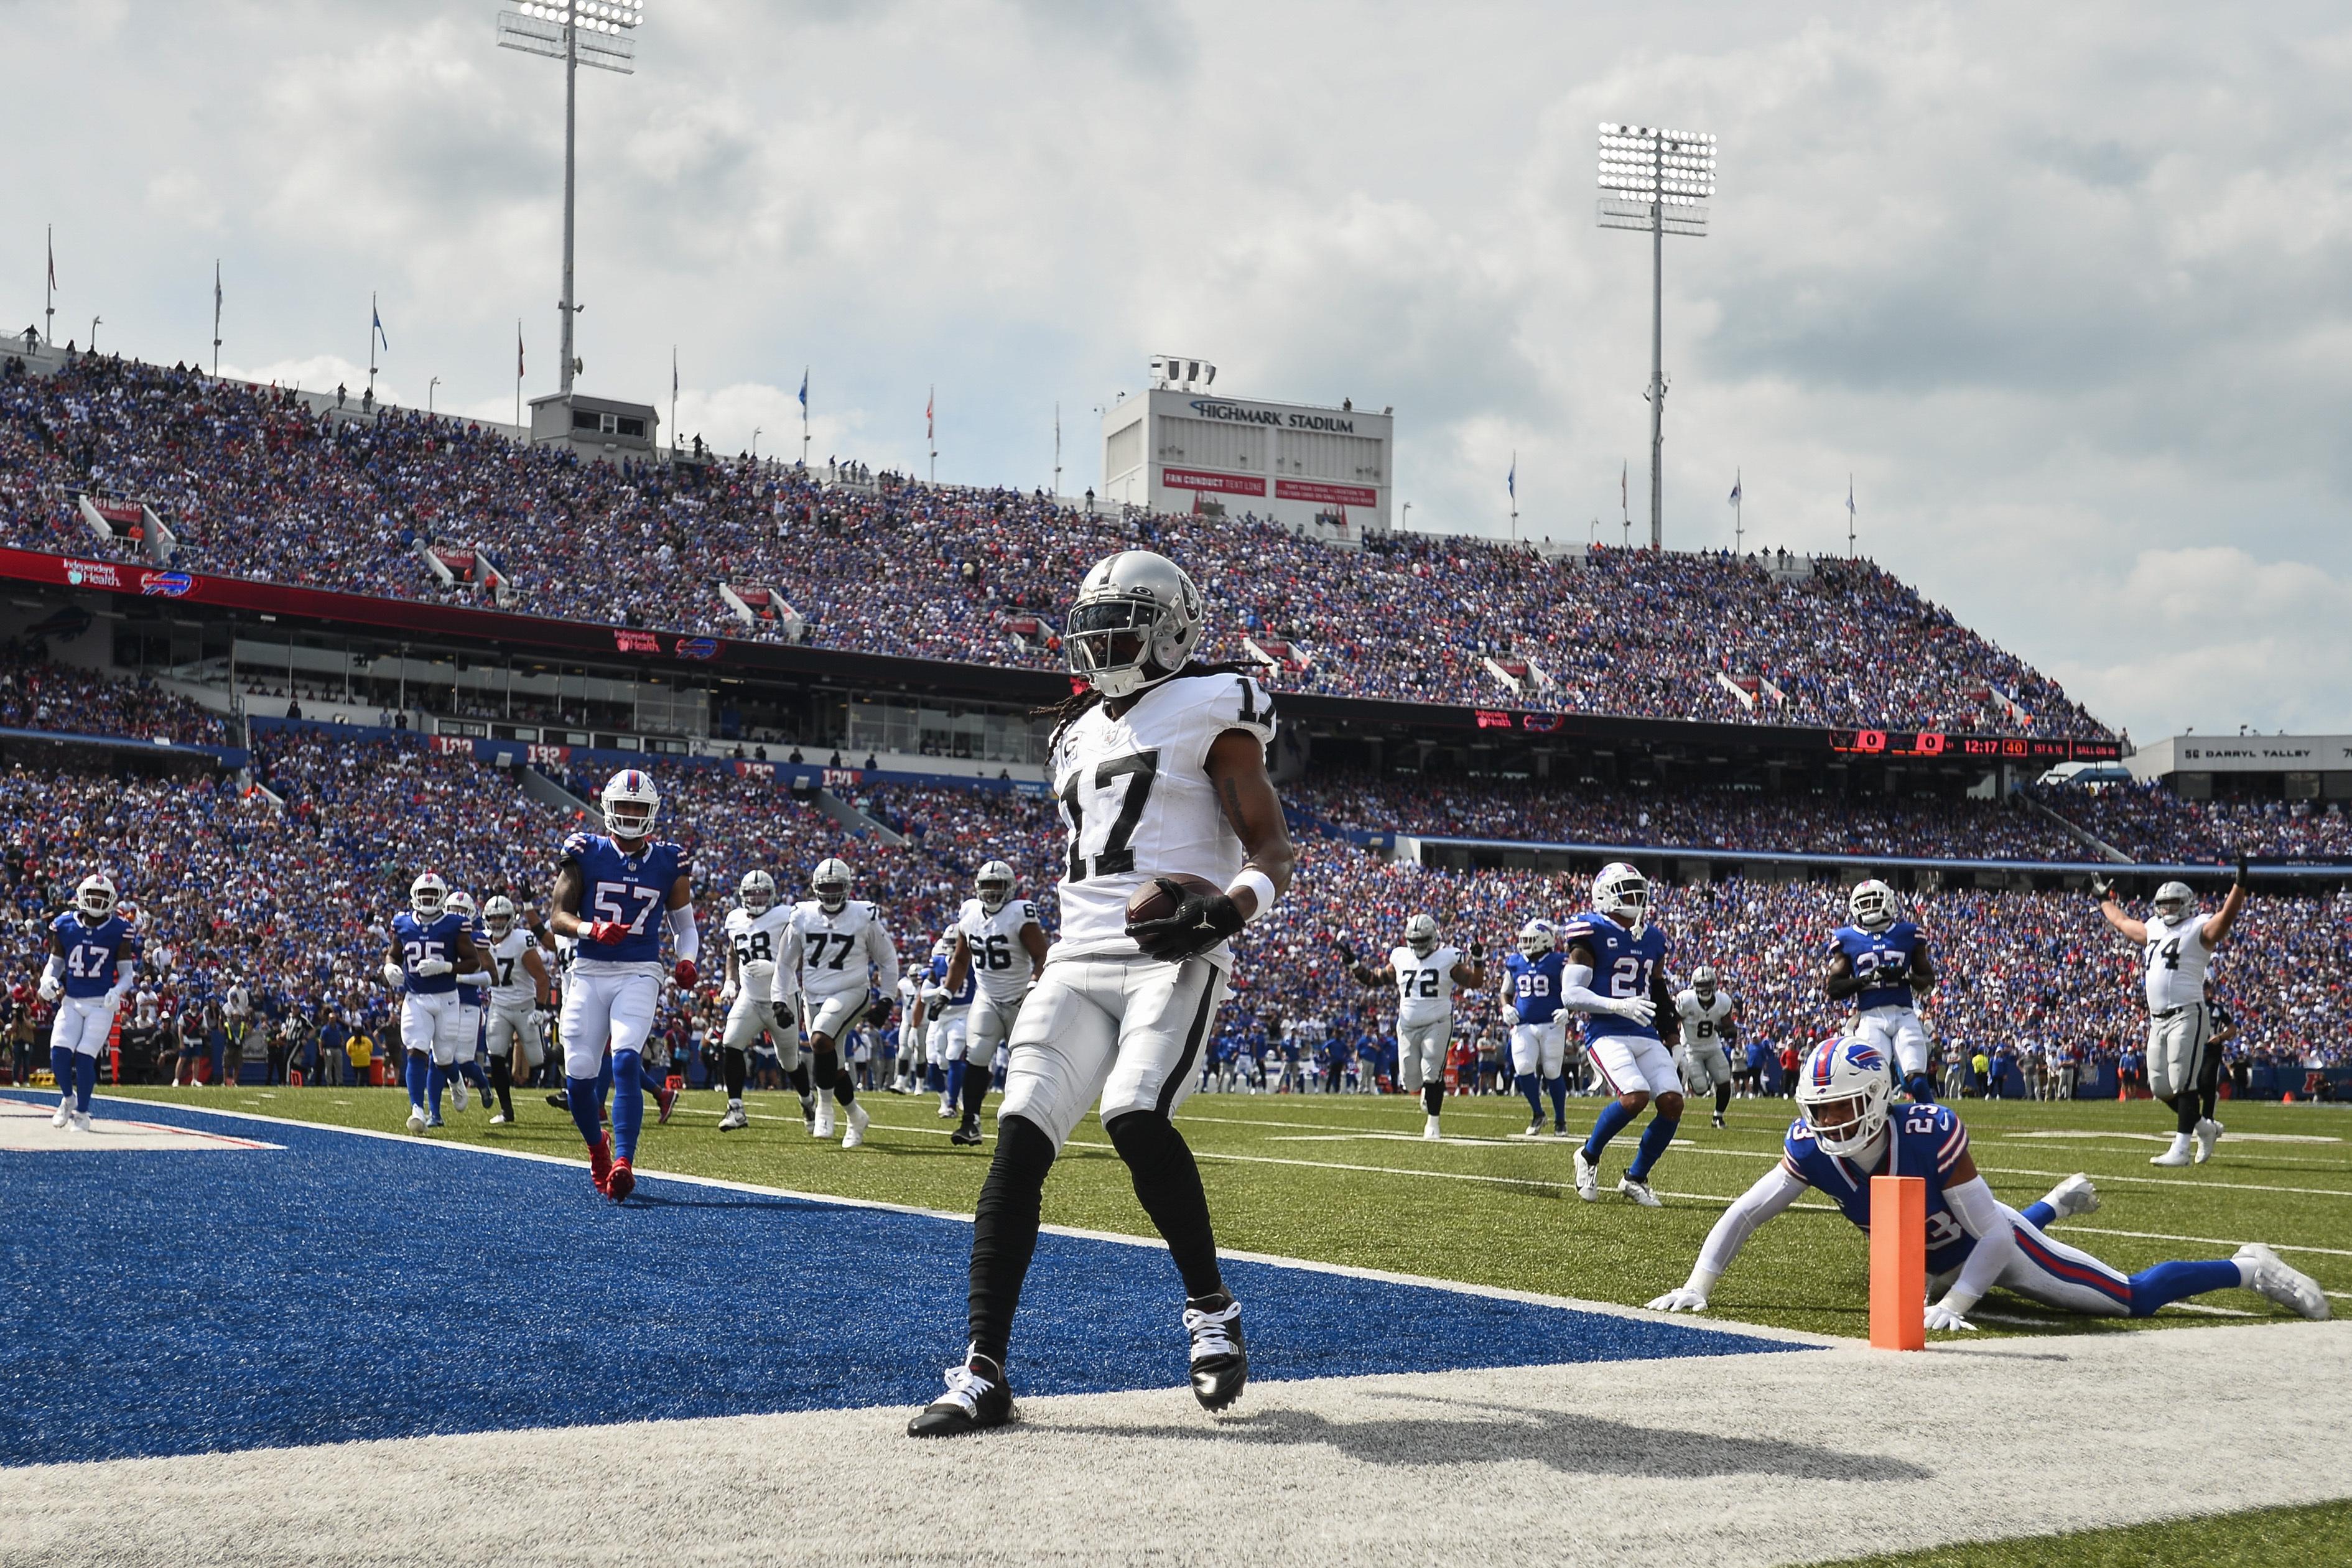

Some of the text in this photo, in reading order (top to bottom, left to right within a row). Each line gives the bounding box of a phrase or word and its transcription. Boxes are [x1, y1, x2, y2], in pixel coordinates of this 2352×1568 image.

[1198, 404, 1354, 433] HIGHMARK STADIUM
[1164, 473, 1263, 492] FAN CONDUCT TEXT LINE
[63, 558, 116, 573] Independent
[1866, 733, 1877, 746] 0
[1925, 736, 1936, 749] 0
[1964, 739, 1999, 754] 12:17
[2006, 743, 2023, 754] 40
[2034, 743, 2046, 753] 1ST
[2076, 745, 2094, 754] BALL
[2096, 746, 2107, 755] ON
[2206, 750, 2257, 758] DARRYL
[2262, 750, 2311, 758] TALLEY
[2342, 748, 2352, 758] 7
[1058, 748, 1161, 884] 17
[593, 881, 661, 935] 57
[404, 940, 445, 973] 25
[734, 930, 773, 966] 68
[806, 933, 855, 970] 77
[968, 933, 1012, 970] 66
[1606, 937, 1618, 947] C
[2147, 937, 2181, 971] 74
[68, 944, 109, 978] 47
[496, 957, 515, 987] 7
[1856, 950, 1906, 990] 27
[1401, 968, 1439, 998] 72
[1517, 973, 1550, 998] 99
[1611, 957, 1654, 1001] 21
[1696, 1021, 1715, 1038] 8
[1905, 1103, 1939, 1134] 23
[1925, 1210, 1961, 1251] 3
